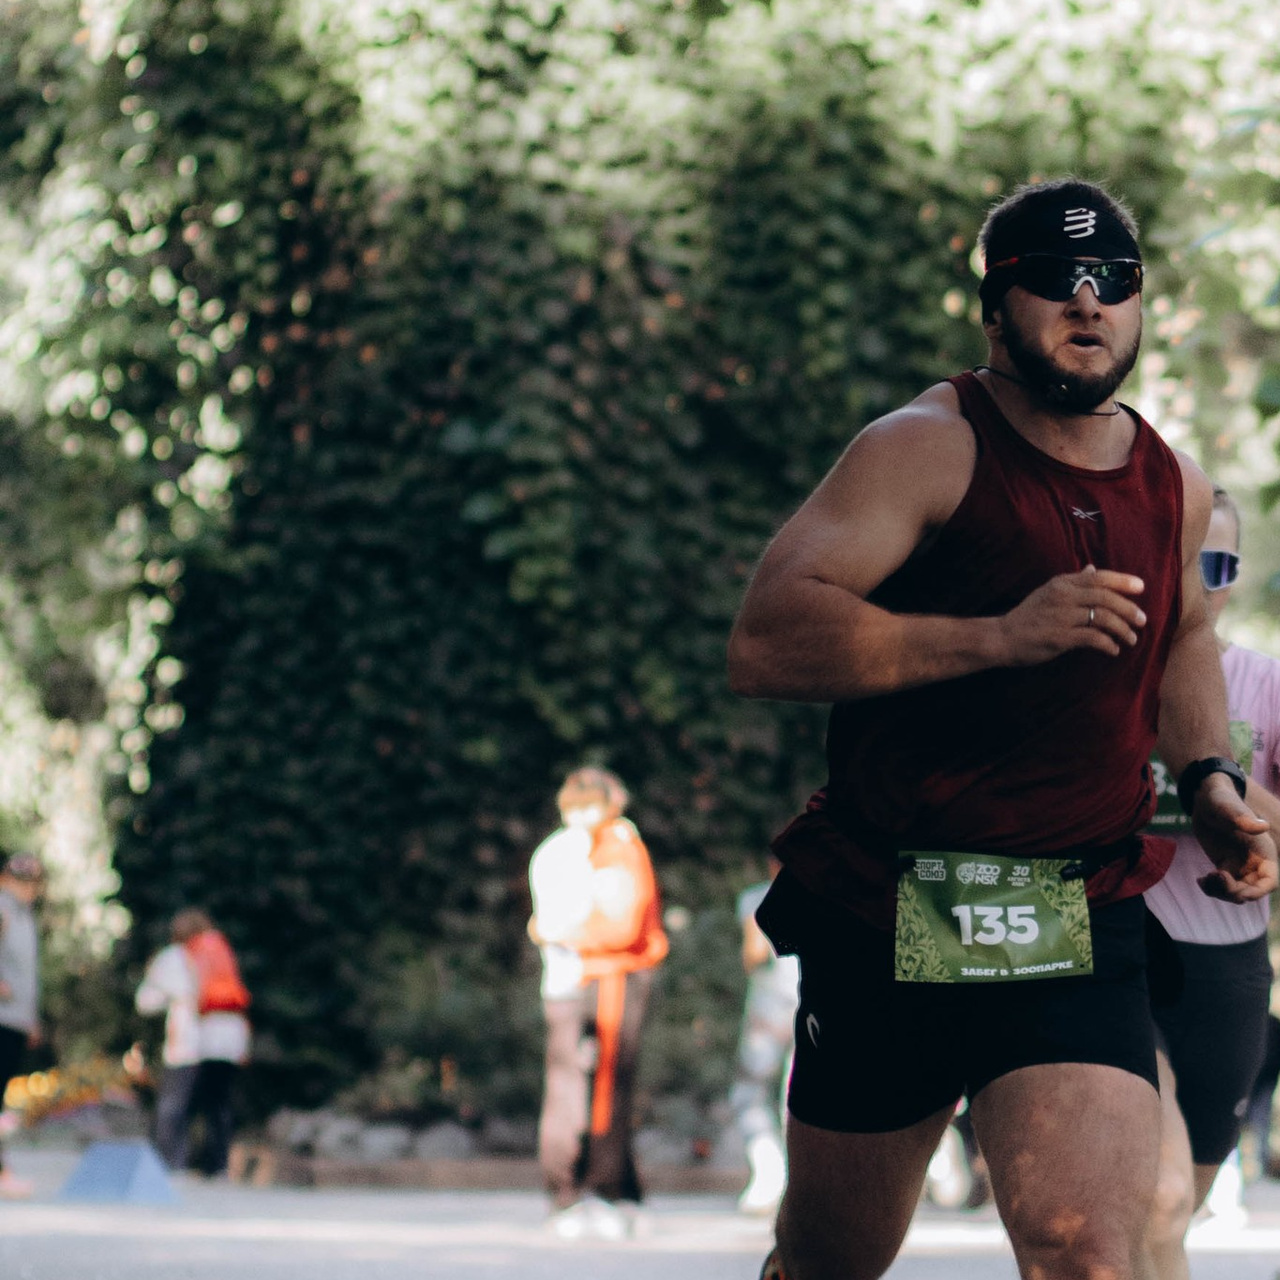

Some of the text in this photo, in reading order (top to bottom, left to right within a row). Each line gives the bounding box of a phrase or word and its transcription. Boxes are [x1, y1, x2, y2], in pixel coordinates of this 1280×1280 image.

[919, 870, 945, 879] СОЮЗ
[976, 864, 1001, 875] ZOO
[1011, 865, 1030, 877] 30
[975, 874, 999, 886] NSK
[951, 904, 1040, 946] 135
[960, 960, 1074, 977] ЗАБЕГ В ЗООПАРКЕ
